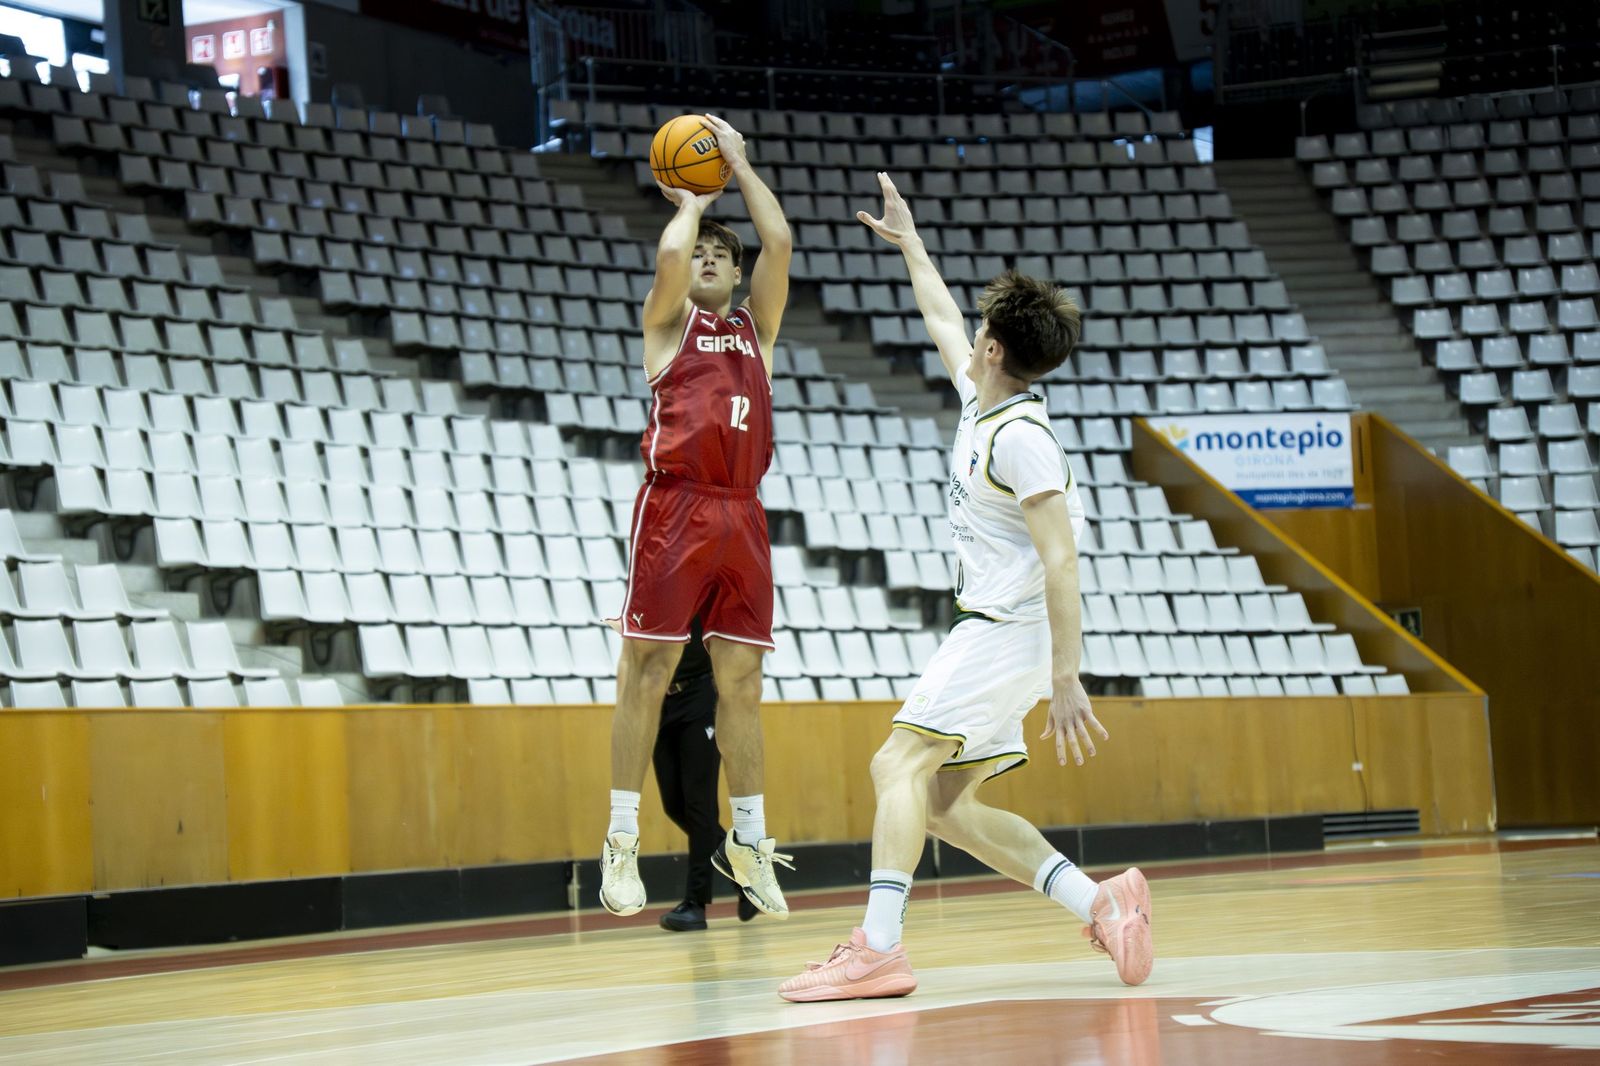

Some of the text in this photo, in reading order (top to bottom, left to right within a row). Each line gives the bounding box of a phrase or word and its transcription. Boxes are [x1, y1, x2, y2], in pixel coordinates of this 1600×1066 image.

[730, 395, 750, 431] 12
[1195, 422, 1343, 455] montepio
[1235, 454, 1294, 467] GIRONA
